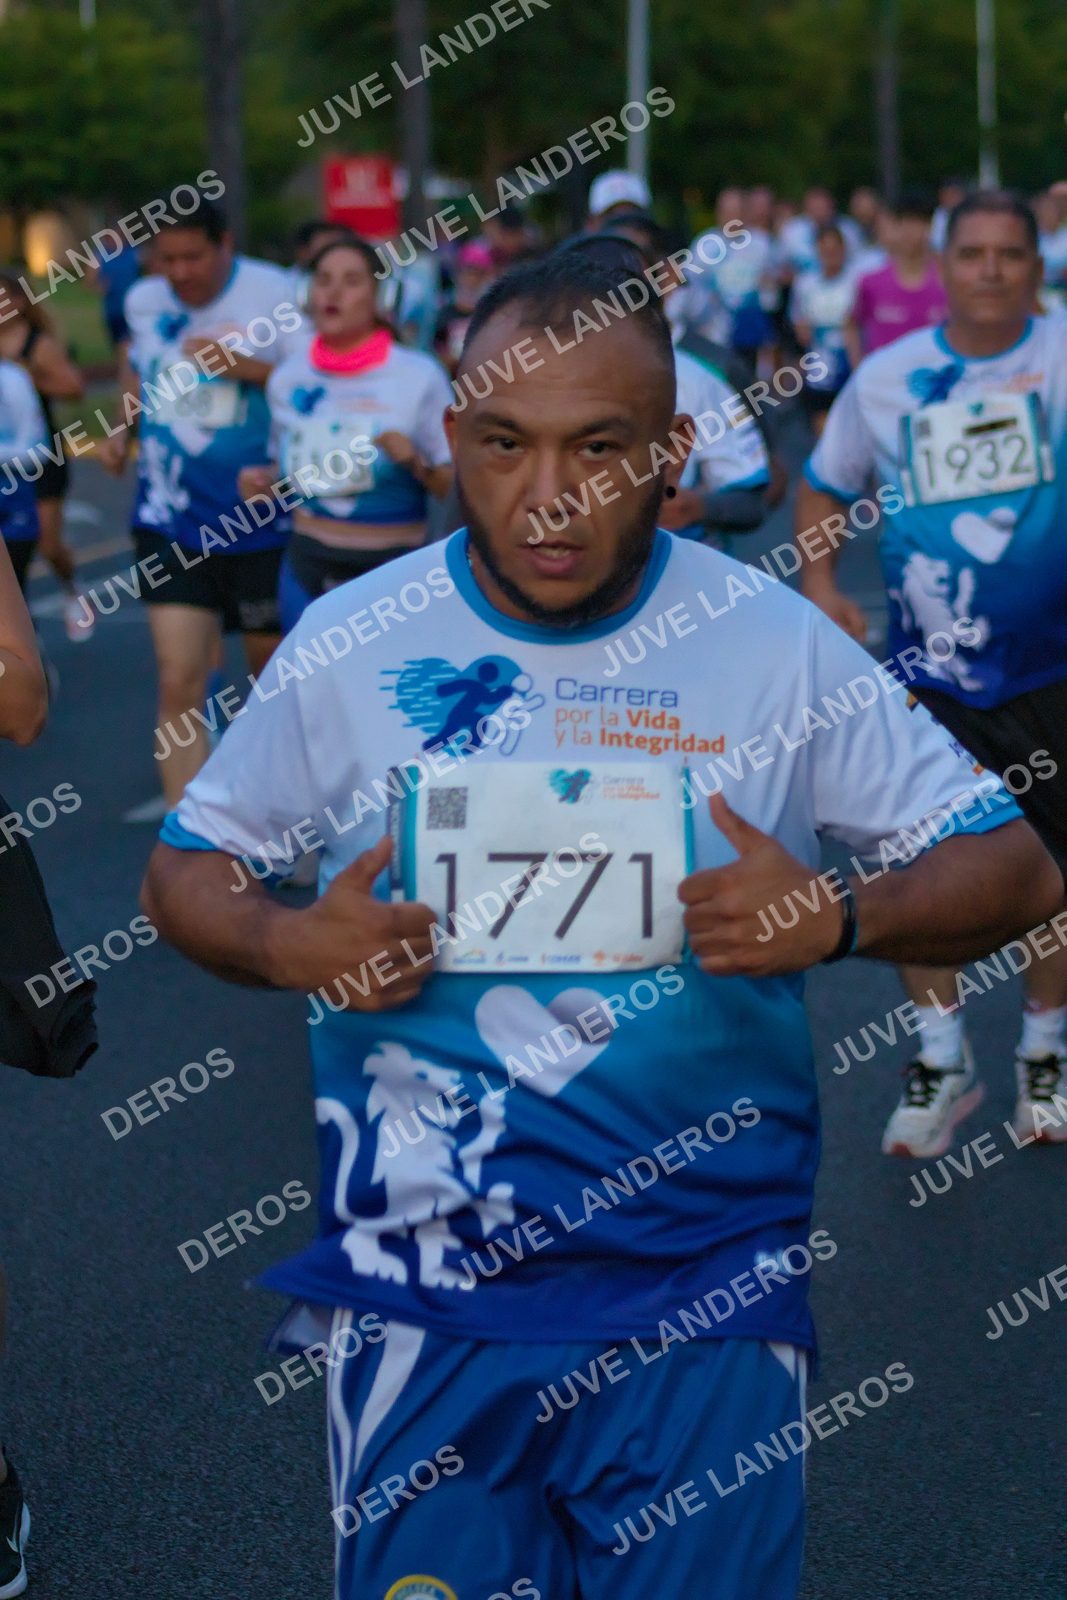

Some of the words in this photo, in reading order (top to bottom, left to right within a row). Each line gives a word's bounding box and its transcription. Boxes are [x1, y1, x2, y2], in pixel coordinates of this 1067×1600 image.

[921, 434, 1034, 488] 1932
[555, 678, 679, 708] Carrera
[555, 707, 592, 727] por
[600, 705, 619, 726] la
[626, 709, 681, 731] Vida
[555, 730, 566, 749] y
[573, 726, 592, 746] la
[600, 728, 725, 756] Integridad
[434, 853, 653, 940] 1771
